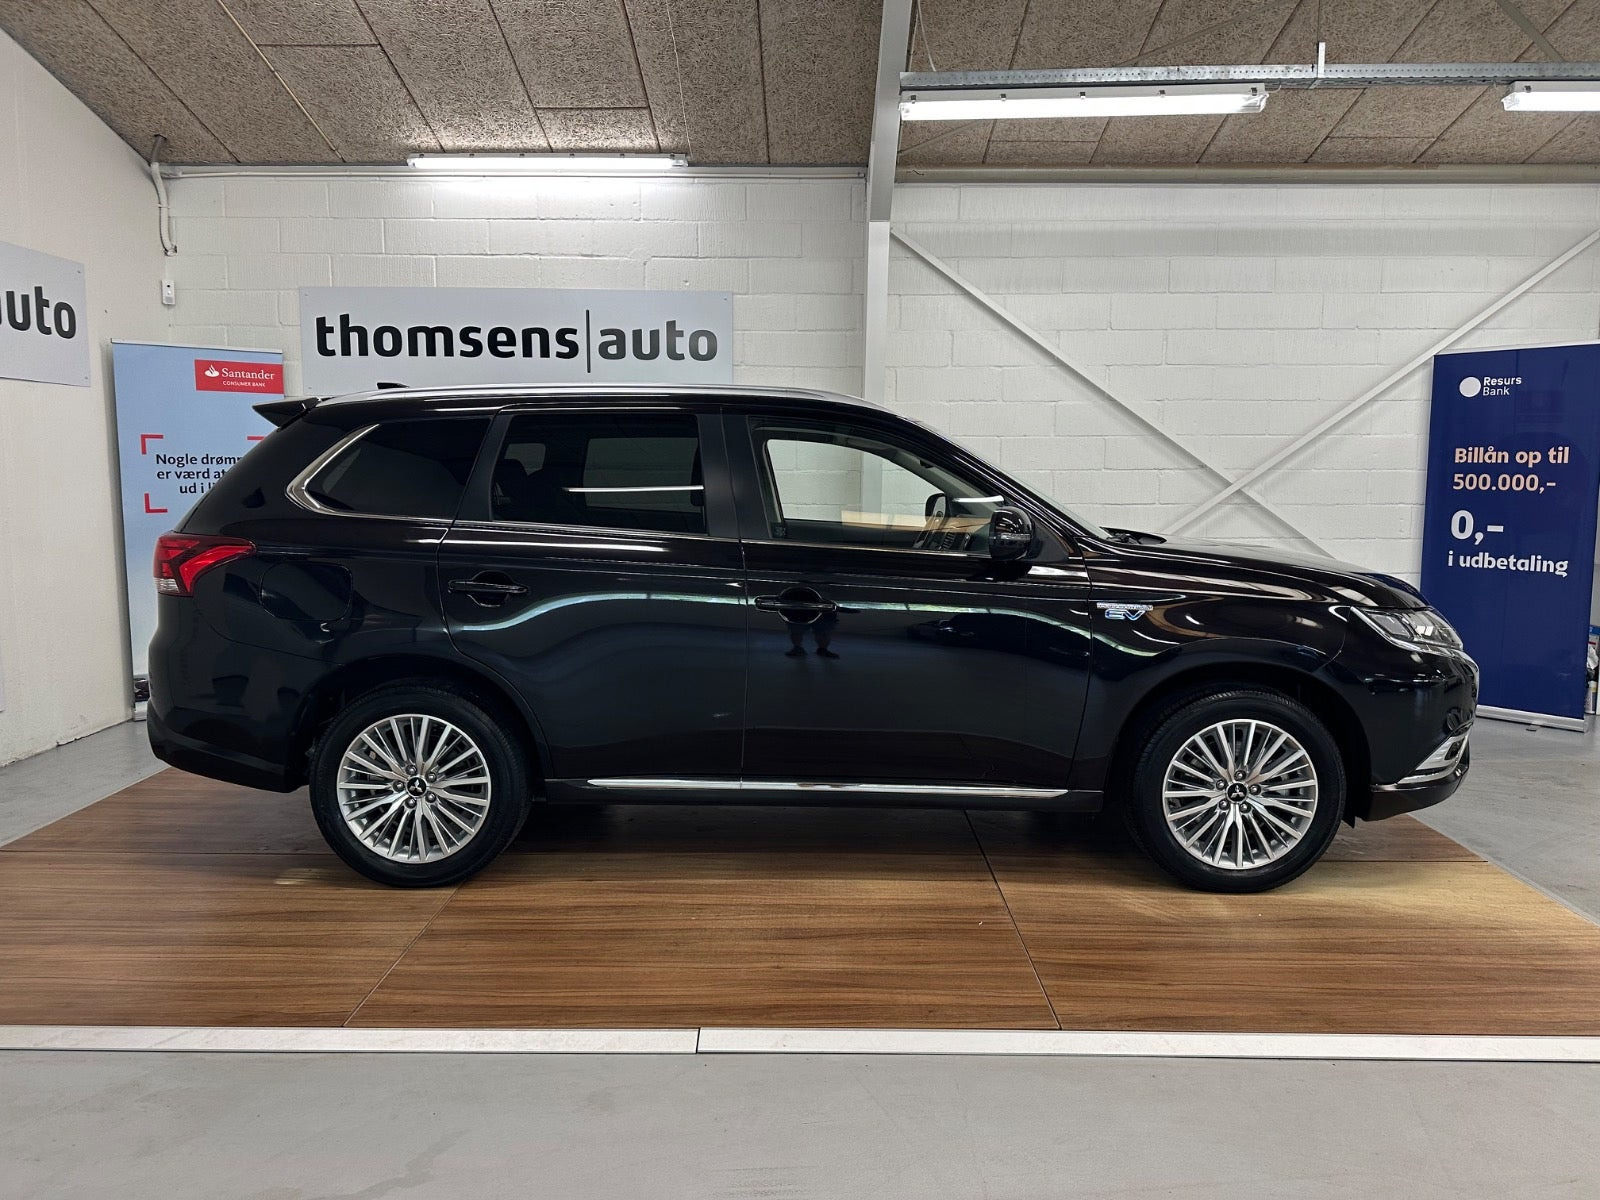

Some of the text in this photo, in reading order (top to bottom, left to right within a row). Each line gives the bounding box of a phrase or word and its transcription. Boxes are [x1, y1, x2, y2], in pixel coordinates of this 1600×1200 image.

[0, 286, 76, 339] uto
[316, 313, 718, 361] thomsens auto
[221, 367, 275, 380] Santander
[1483, 376, 1522, 386] Resurs
[1482, 386, 1510, 396] Bank
[156, 453, 198, 468] Nogle
[1454, 445, 1570, 468] Billån op til
[157, 470, 171, 479] er
[175, 468, 210, 479] værd
[179, 482, 197, 494] ud
[200, 482, 205, 494] i
[1452, 473, 1556, 494] 500.000,-
[1450, 509, 1504, 546] 0,-
[1448, 550, 1569, 577] i udbetaling
